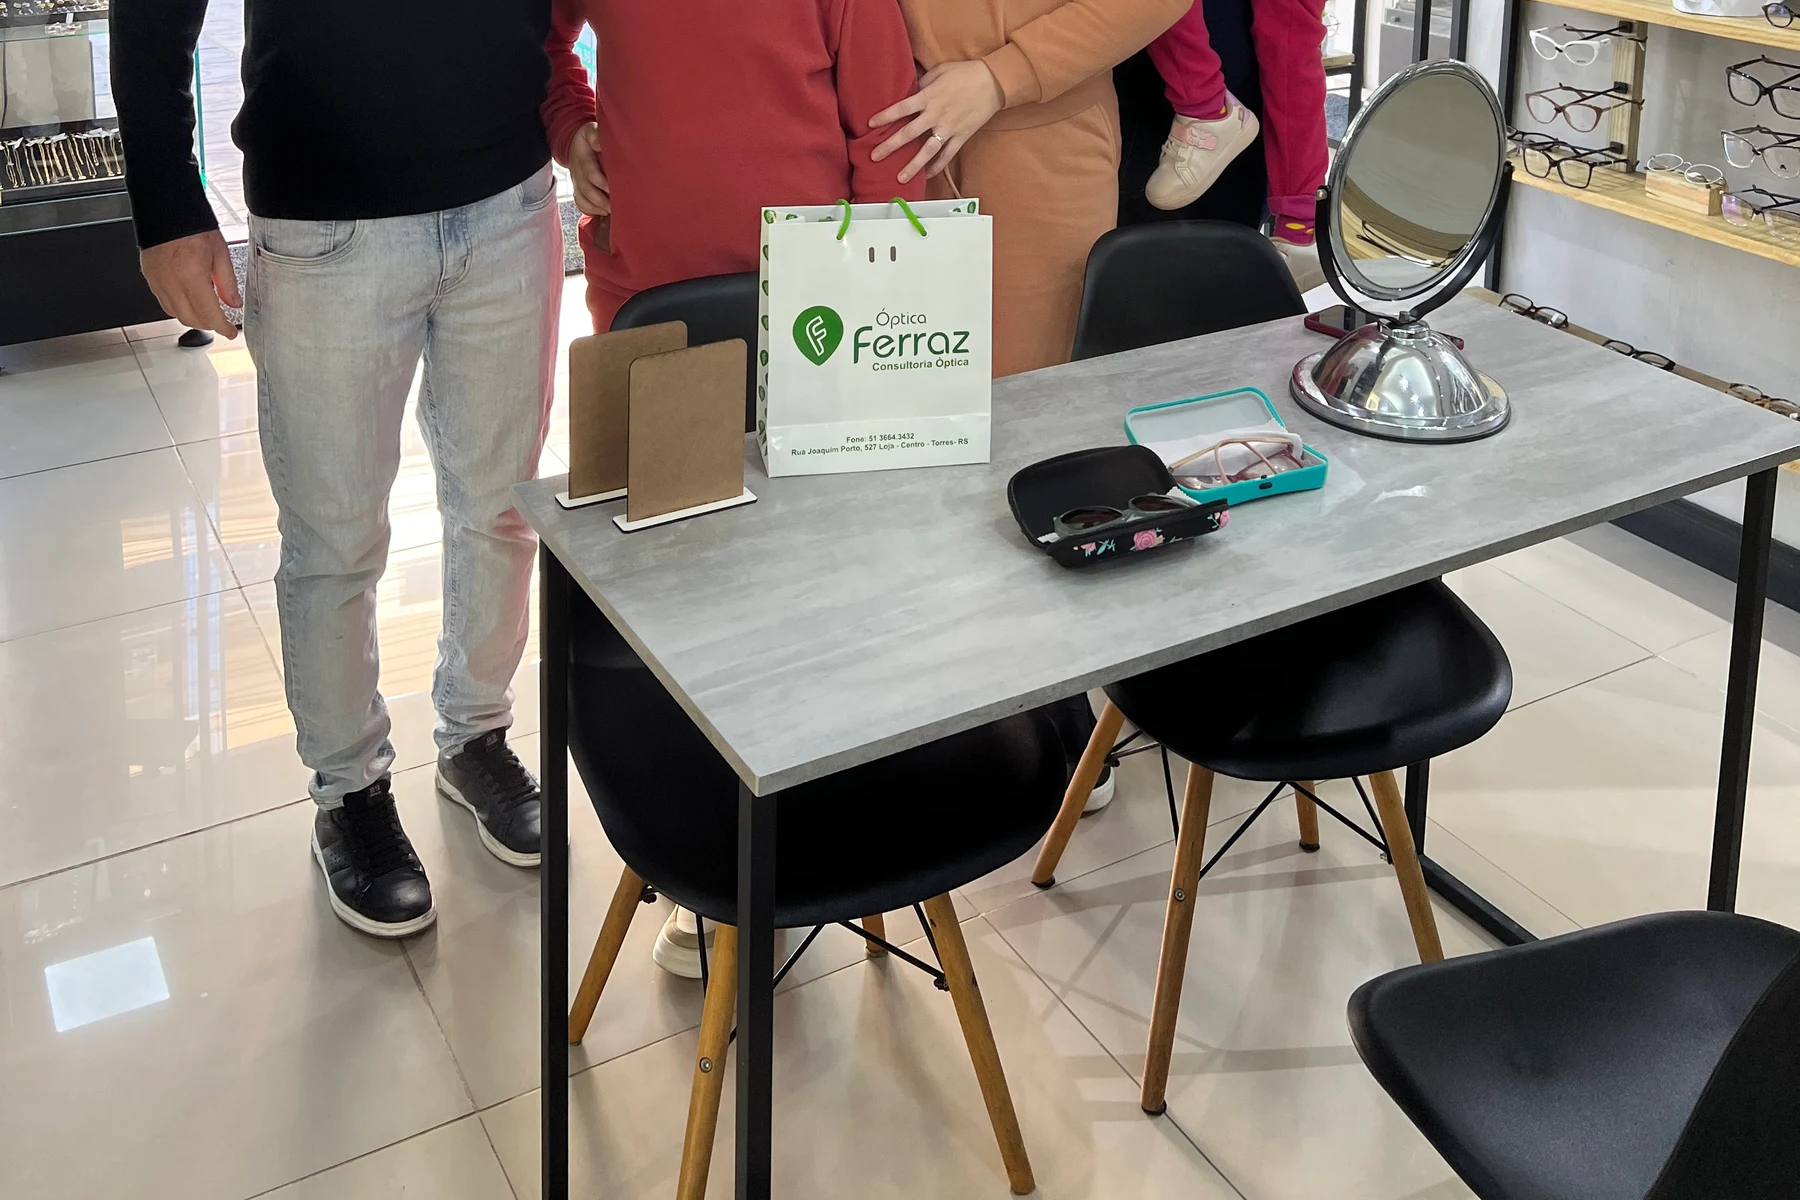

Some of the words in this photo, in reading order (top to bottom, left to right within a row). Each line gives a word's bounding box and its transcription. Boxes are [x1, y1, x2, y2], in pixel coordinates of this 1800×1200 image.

[876, 308, 927, 329] Óptica
[853, 325, 970, 365] Ferraz
[872, 360, 933, 372] Consultoria
[808, 447, 839, 455] Joaquim
[841, 445, 863, 453] Porto,
[879, 443, 895, 451] Loja
[901, 441, 925, 449] Centro
